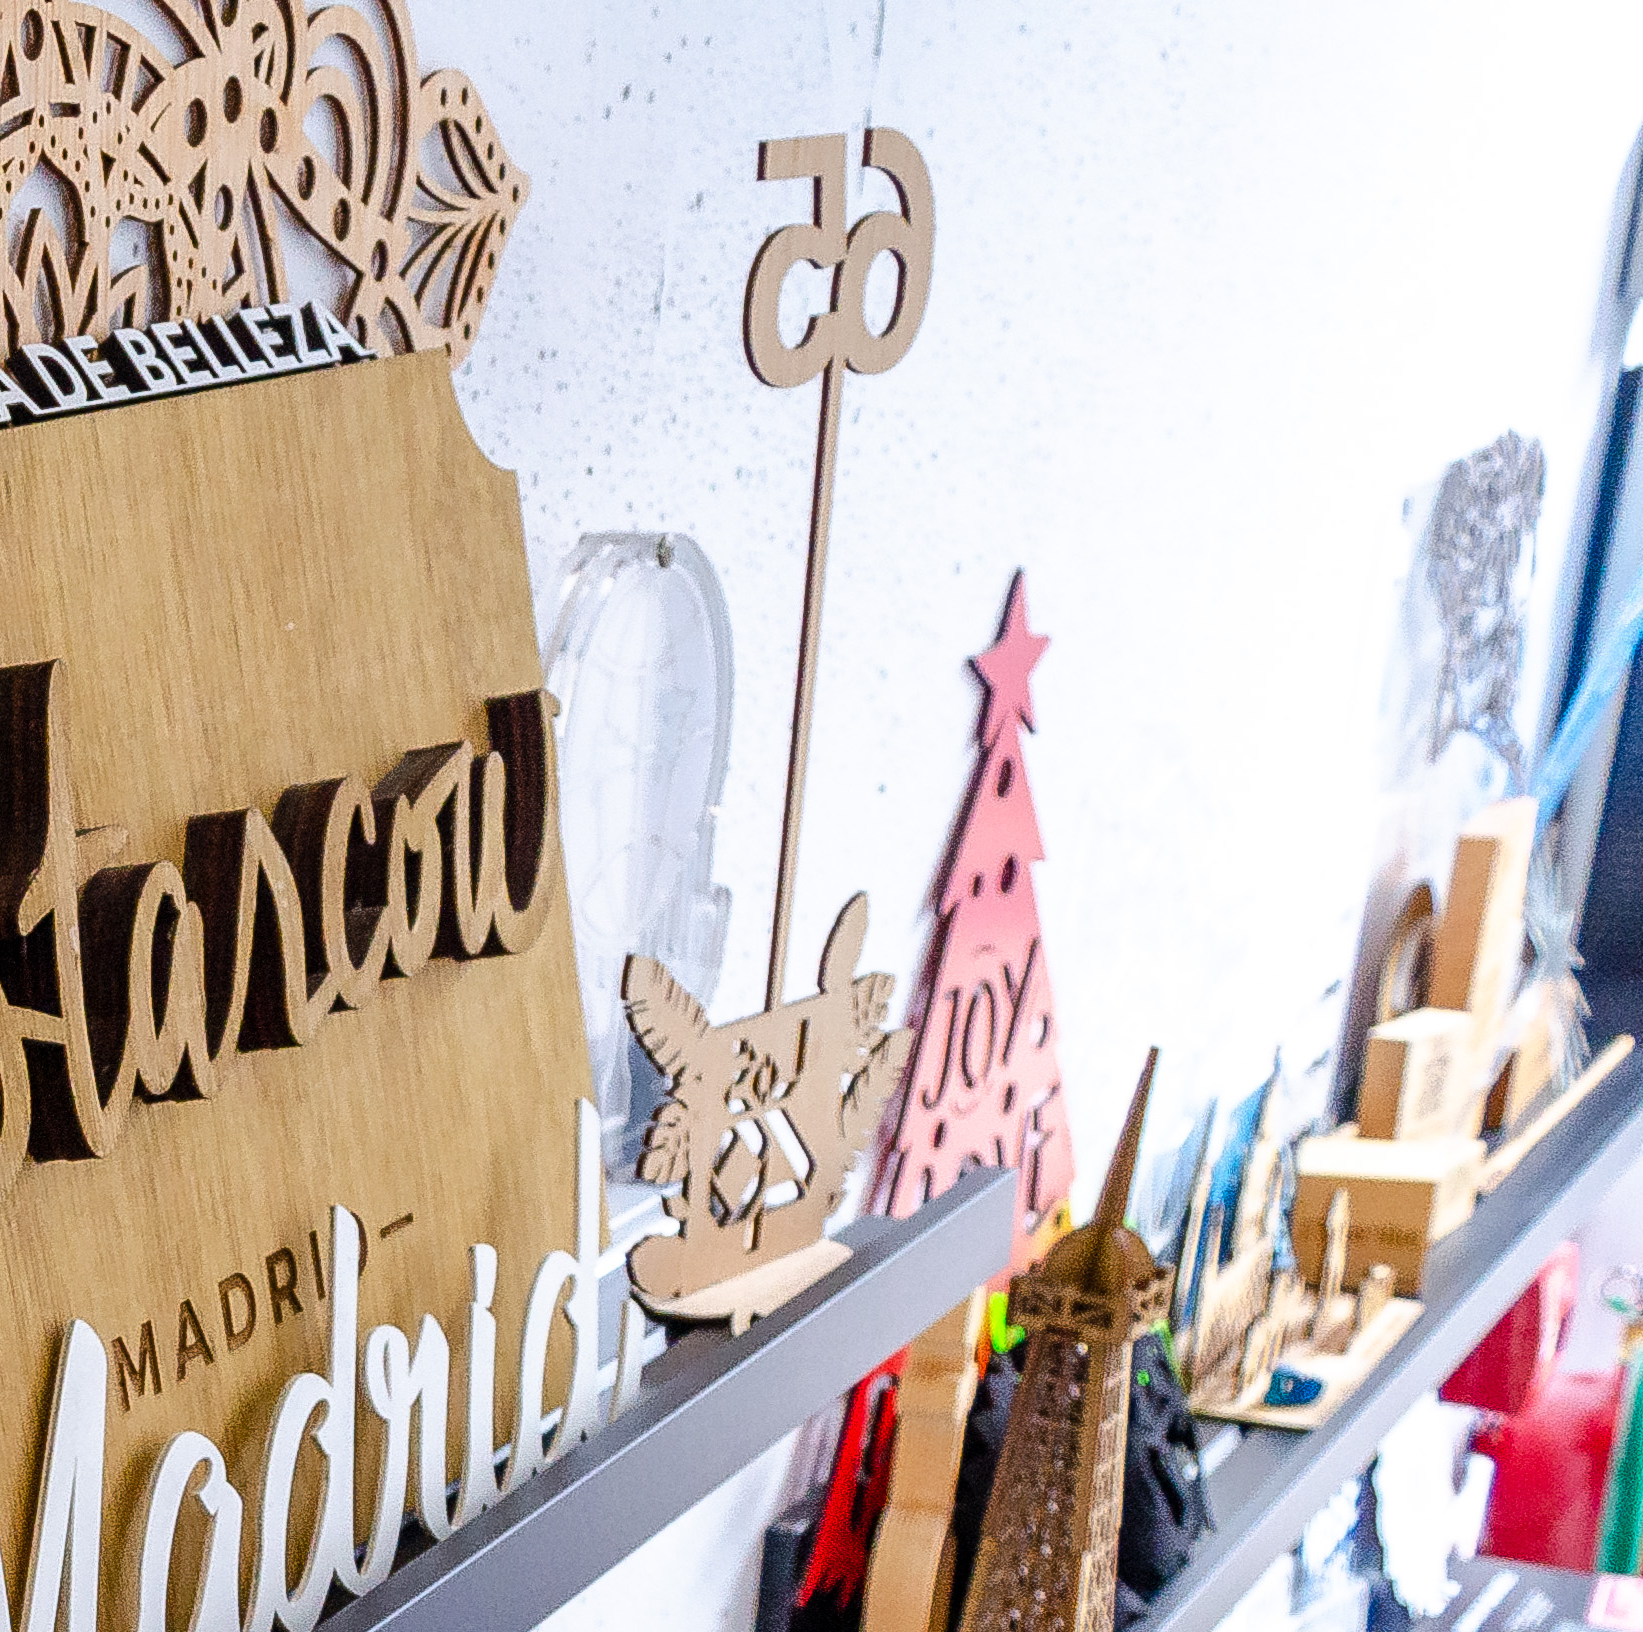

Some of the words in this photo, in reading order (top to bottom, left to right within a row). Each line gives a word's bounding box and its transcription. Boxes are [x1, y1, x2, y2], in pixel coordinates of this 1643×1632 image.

[27, 334, 127, 414] DE
[114, 299, 377, 394] BELLEZA
[921, 937, 1040, 1109] JOY
